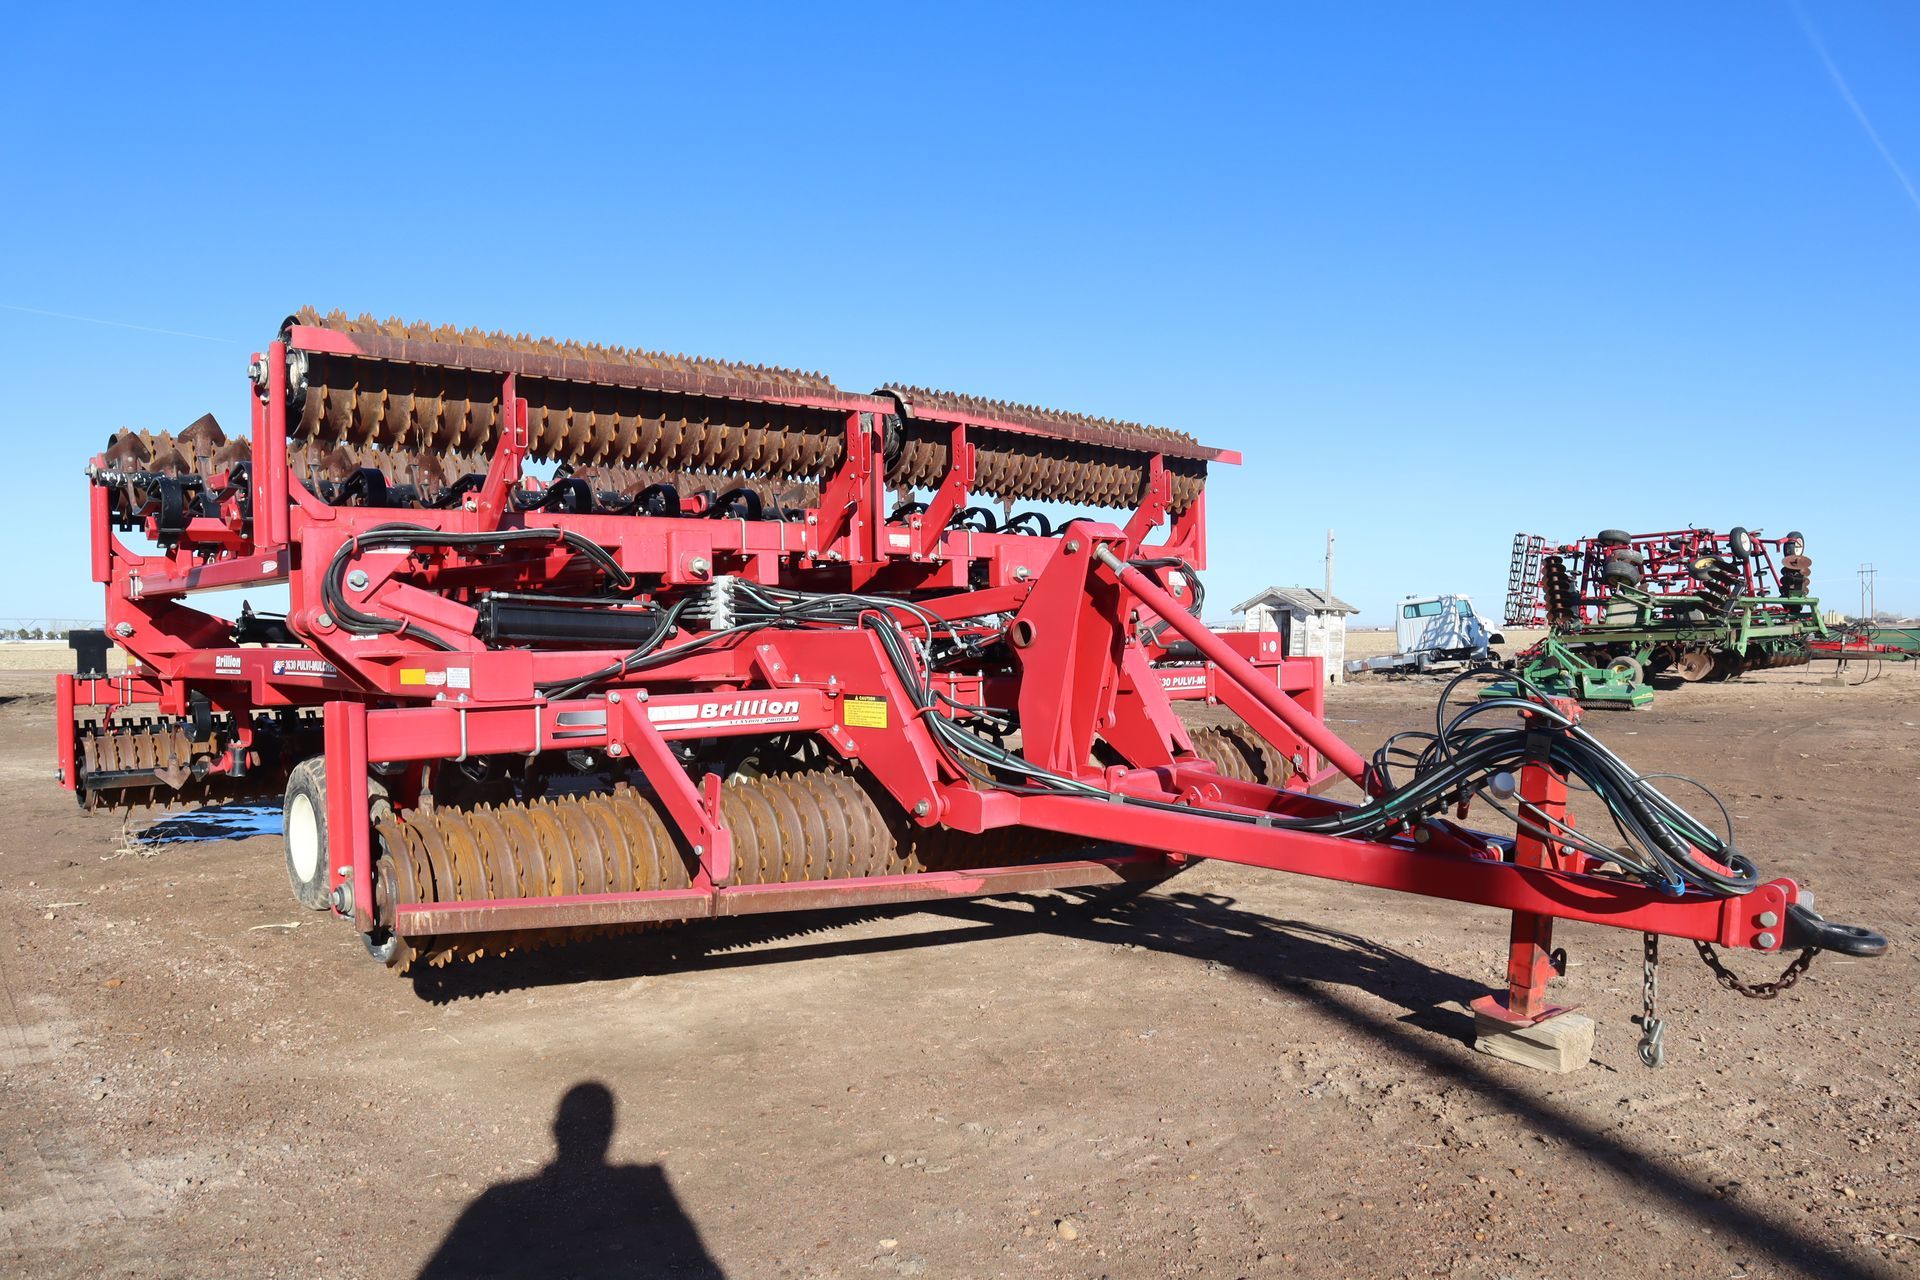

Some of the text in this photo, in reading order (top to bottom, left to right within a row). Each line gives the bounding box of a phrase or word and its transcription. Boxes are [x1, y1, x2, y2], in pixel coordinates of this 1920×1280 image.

[216, 654, 241, 668] Brillion
[285, 659, 296, 671] 3630
[1160, 677, 1171, 687] 30
[701, 699, 799, 719] Brillion
